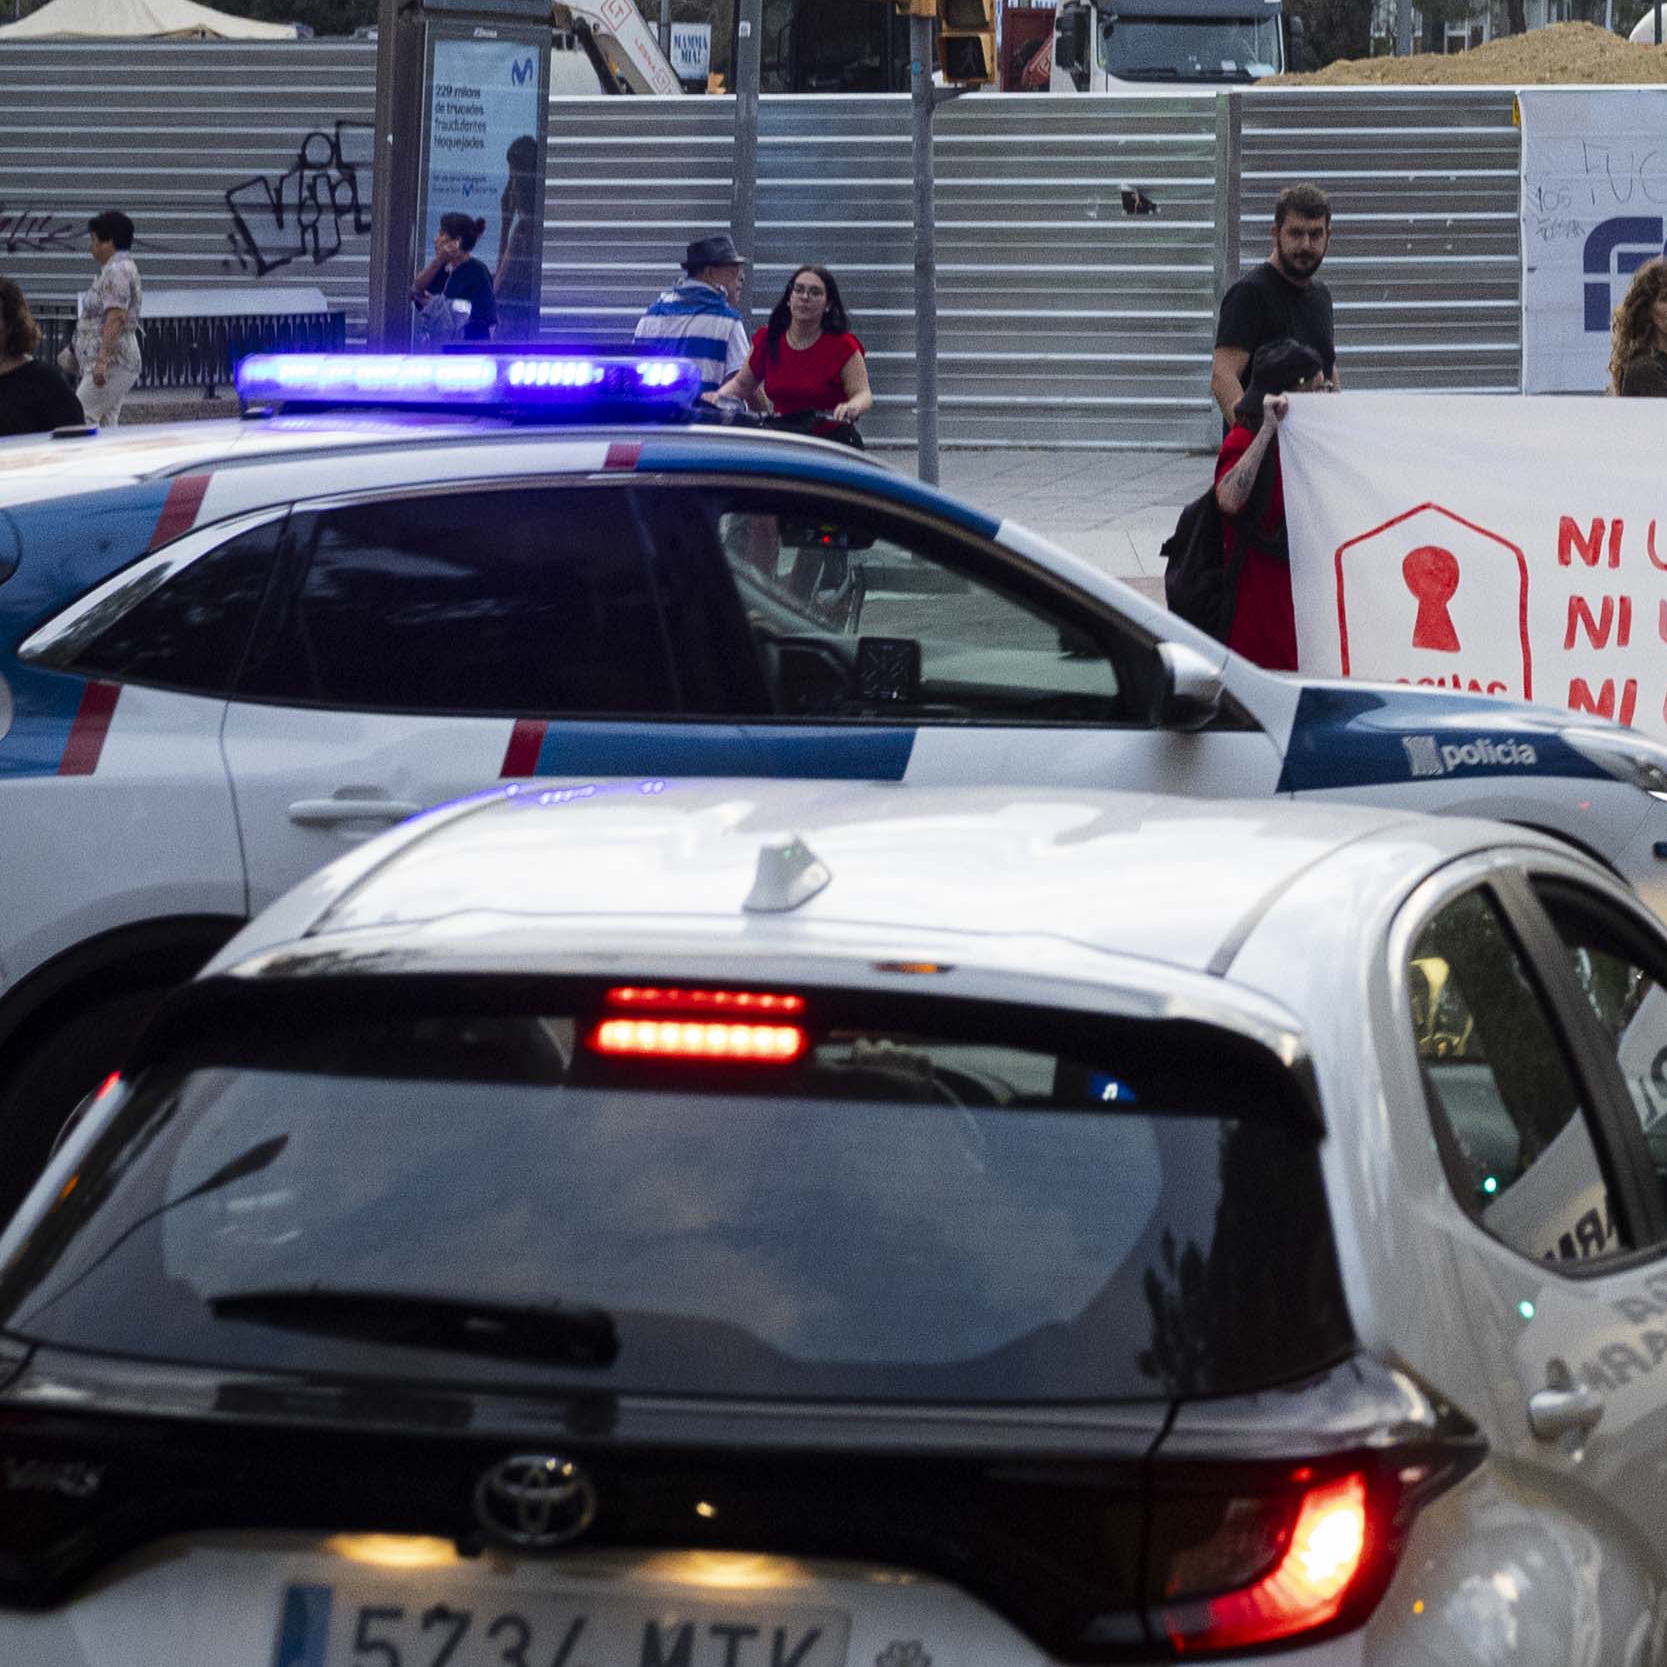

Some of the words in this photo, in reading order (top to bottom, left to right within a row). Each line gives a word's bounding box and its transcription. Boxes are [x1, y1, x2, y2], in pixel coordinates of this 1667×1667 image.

[1558, 515, 1625, 568] NI
[1563, 594, 1632, 650] NI
[1567, 677, 1638, 729] NI
[1441, 738, 1539, 772] policia
